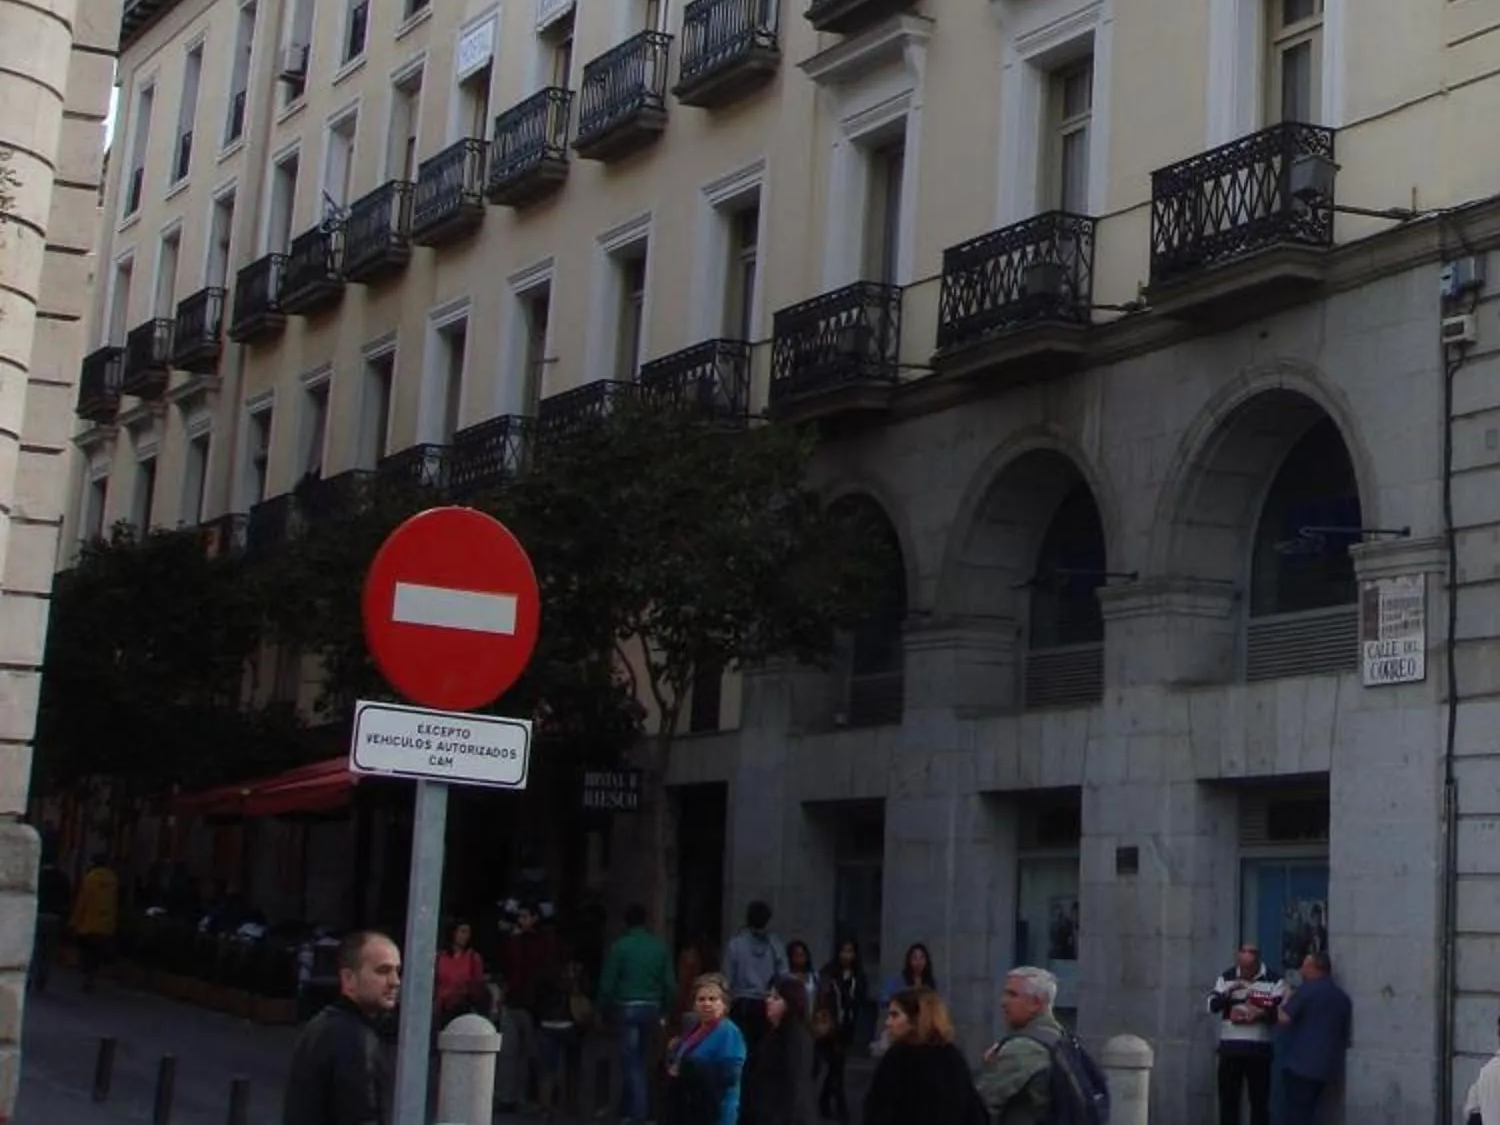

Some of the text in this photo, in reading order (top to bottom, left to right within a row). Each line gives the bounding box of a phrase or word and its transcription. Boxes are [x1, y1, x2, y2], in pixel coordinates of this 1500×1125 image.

[1368, 640, 1400, 659] CALLE
[1370, 658, 1417, 680] CORREO
[417, 724, 471, 739] EXCEPTO
[366, 733, 518, 760] VEHICULOS AUTORIZADOS
[429, 756, 453, 767] CAM
